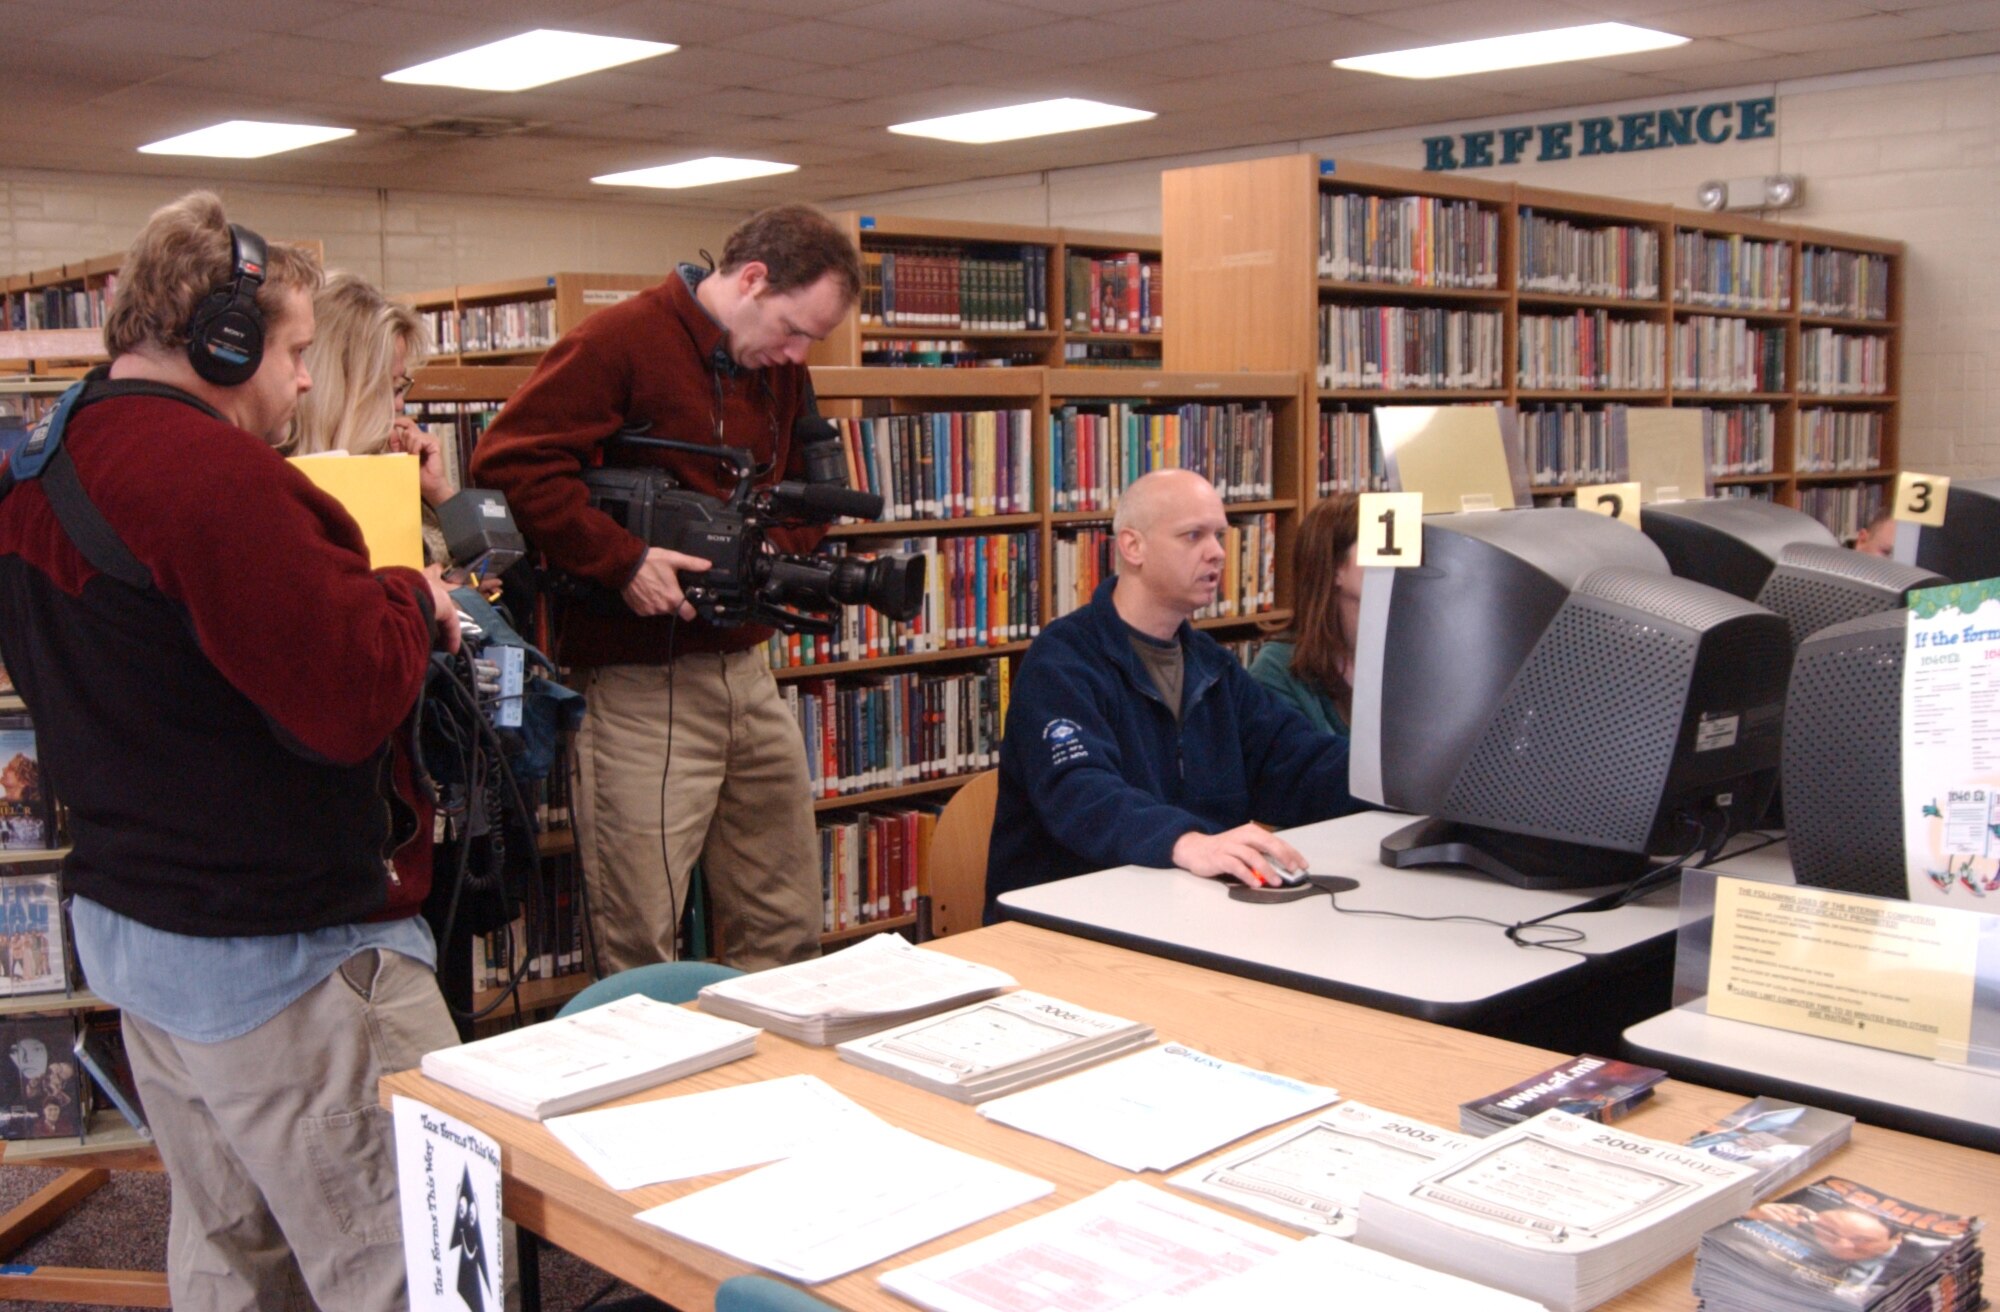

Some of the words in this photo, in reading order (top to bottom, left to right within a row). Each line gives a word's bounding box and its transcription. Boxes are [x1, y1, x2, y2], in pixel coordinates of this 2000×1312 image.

[1422, 97, 1776, 172] REFERENCE
[223, 326, 246, 338] SONY
[1908, 481, 1933, 514] 3
[707, 534, 732, 543] SONY
[1377, 509, 1402, 556] 1
[1915, 632, 1928, 648] If
[1932, 630, 1959, 646] the
[1738, 887, 1752, 897] THE
[1831, 901, 1845, 911] THE
[1778, 994, 1815, 1010] COMPUTER
[1834, 1004, 1844, 1014] TO
[1497, 1057, 1606, 1109] www.af.mil
[420, 1113, 440, 1134] Tax
[440, 1121, 467, 1148] Forms
[467, 1134, 487, 1158] This
[1381, 1121, 1439, 1143] 2005
[1593, 1134, 1654, 1155] 2005
[424, 1139, 435, 1173] Way
[426, 1178, 438, 1211] This
[430, 1216, 441, 1261] Forms
[434, 1267, 444, 1296] Tax
